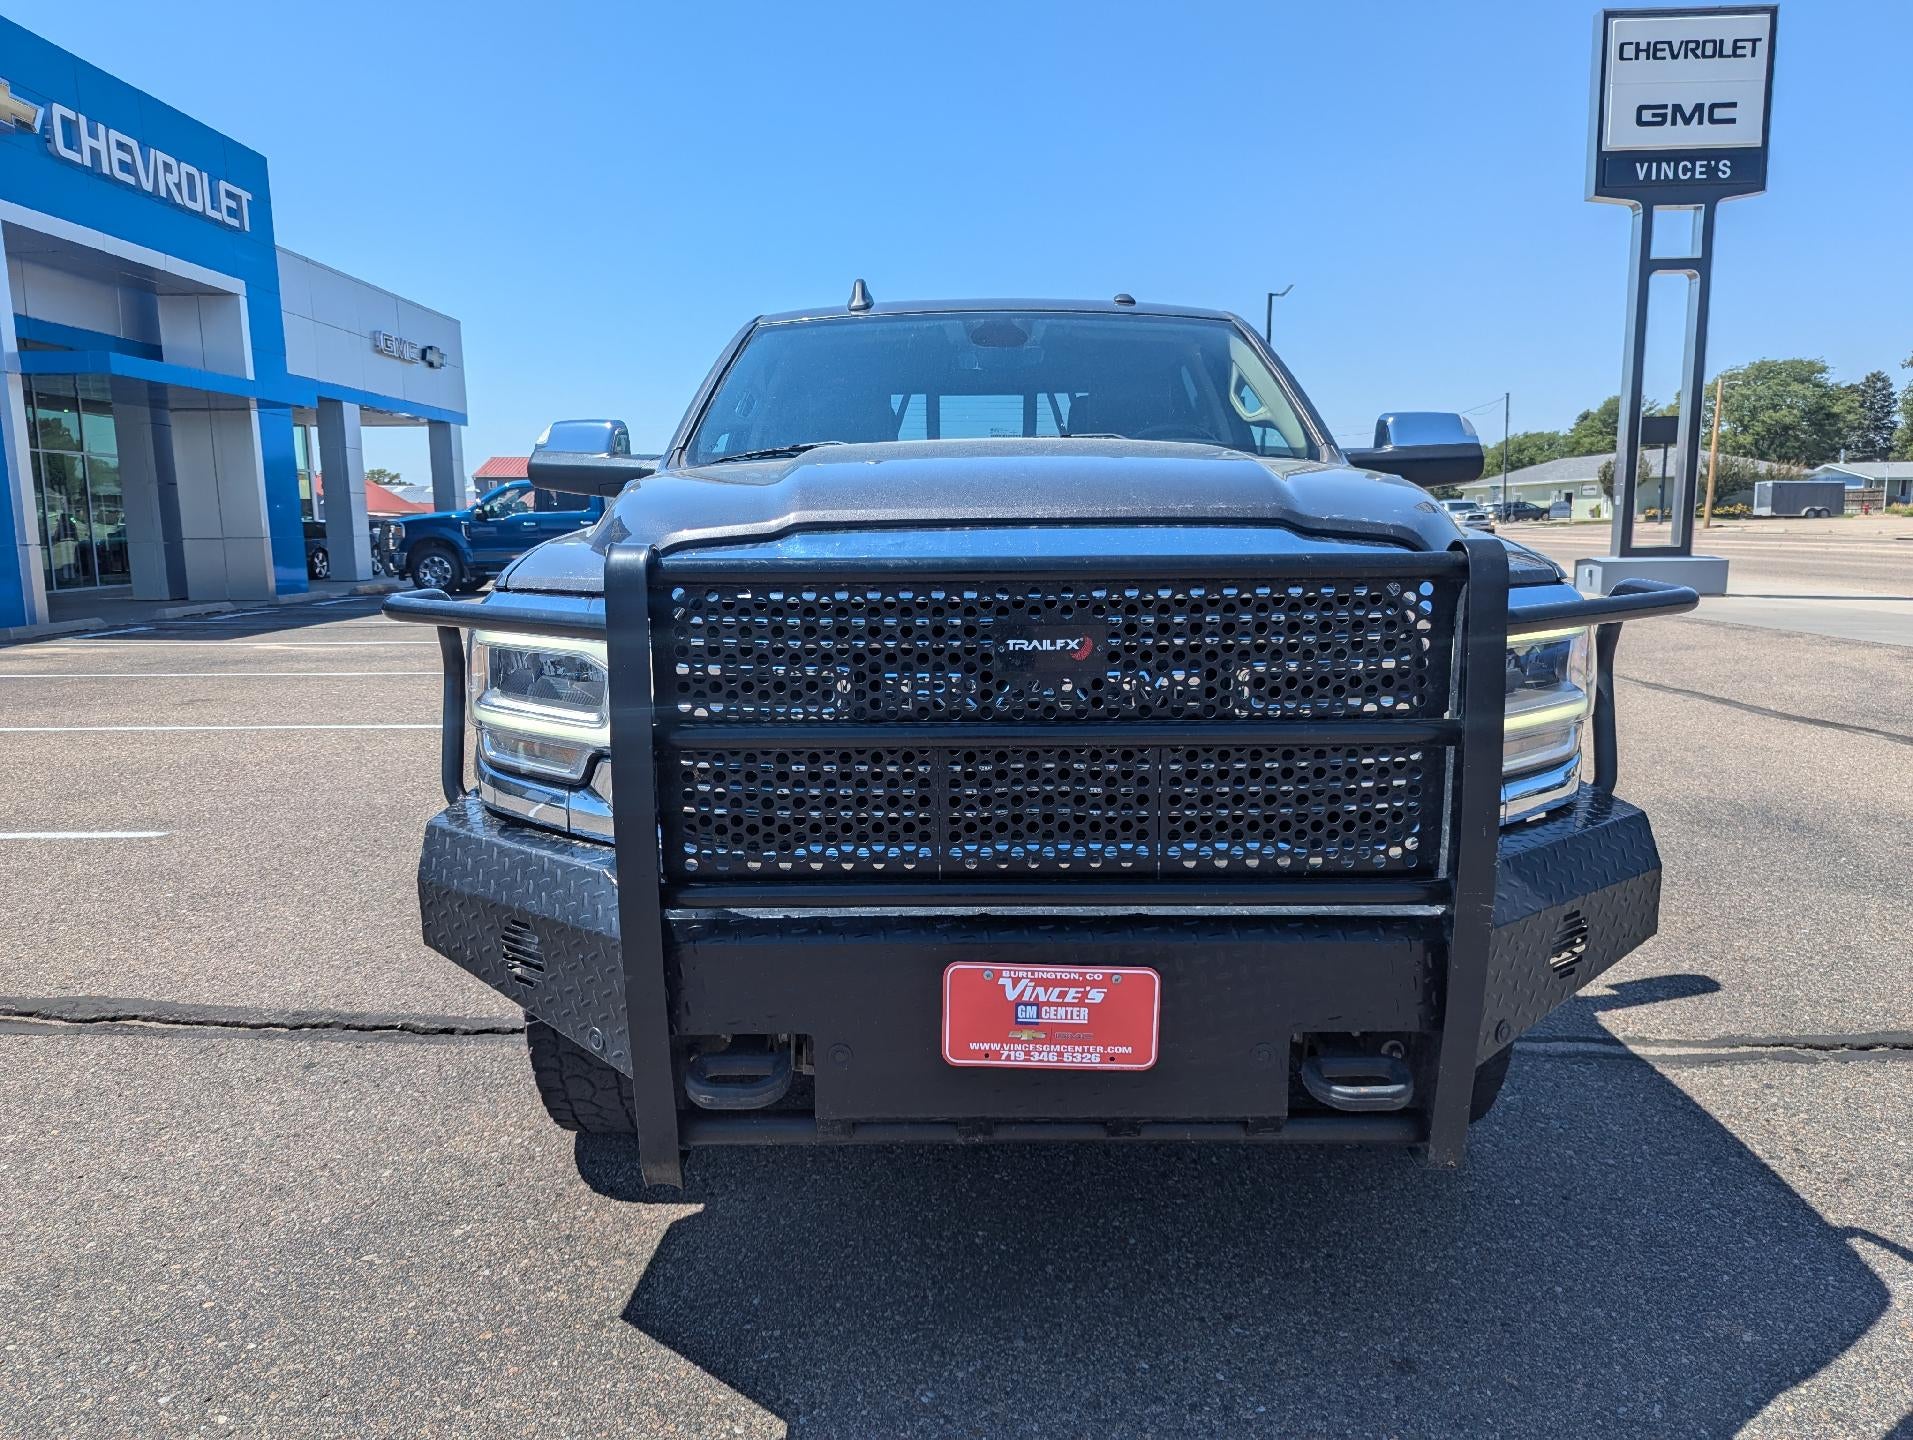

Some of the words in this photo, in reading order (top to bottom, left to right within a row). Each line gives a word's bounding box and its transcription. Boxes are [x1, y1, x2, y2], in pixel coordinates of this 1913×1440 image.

[1618, 37, 1763, 62] CHEVROLET
[1635, 101, 1738, 128] GMC
[51, 102, 253, 232] CHEVROLET
[1635, 159, 1732, 181] VINCE'S
[380, 331, 420, 365] GMC
[1006, 637, 1084, 651] TRAILFX
[1001, 970, 1083, 981] BURLINGTON,
[1085, 973, 1103, 981] CO
[1017, 1005, 1038, 1019] GM
[1041, 1005, 1089, 1021] CENTER
[969, 1042, 1132, 1054] WWW.VINCESGMCENTER.COM
[999, 1050, 1101, 1063] 719-346-5326
